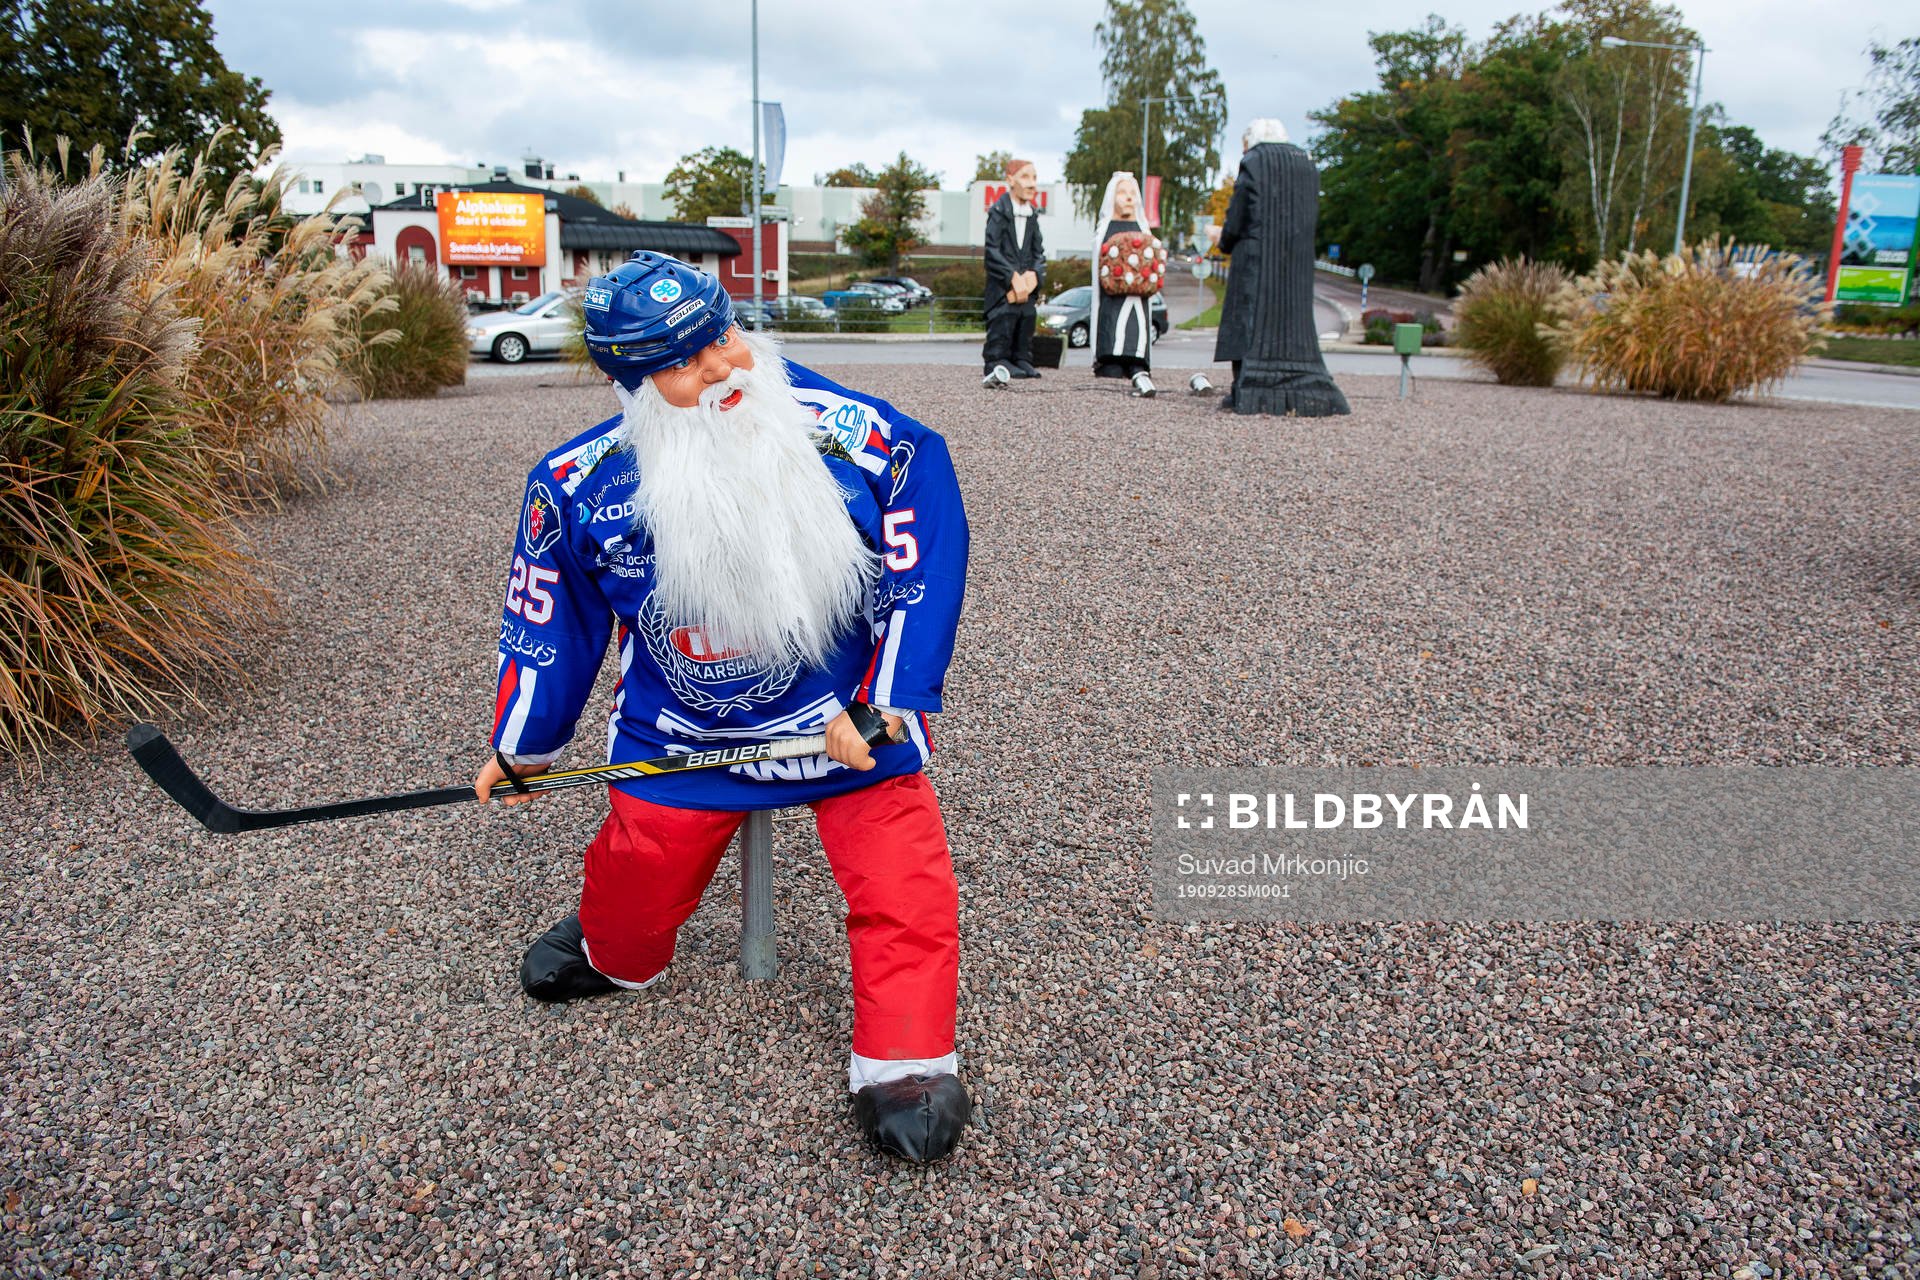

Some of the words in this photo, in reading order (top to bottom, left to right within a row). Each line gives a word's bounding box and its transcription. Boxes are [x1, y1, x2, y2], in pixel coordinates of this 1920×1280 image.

[985, 185, 1047, 208] MXI
[456, 199, 526, 215] Alphakurs
[455, 215, 480, 226] Start
[490, 216, 528, 227] oktober
[449, 242, 490, 254] Svenska
[489, 242, 524, 257] kyrkan
[506, 554, 560, 626] 25
